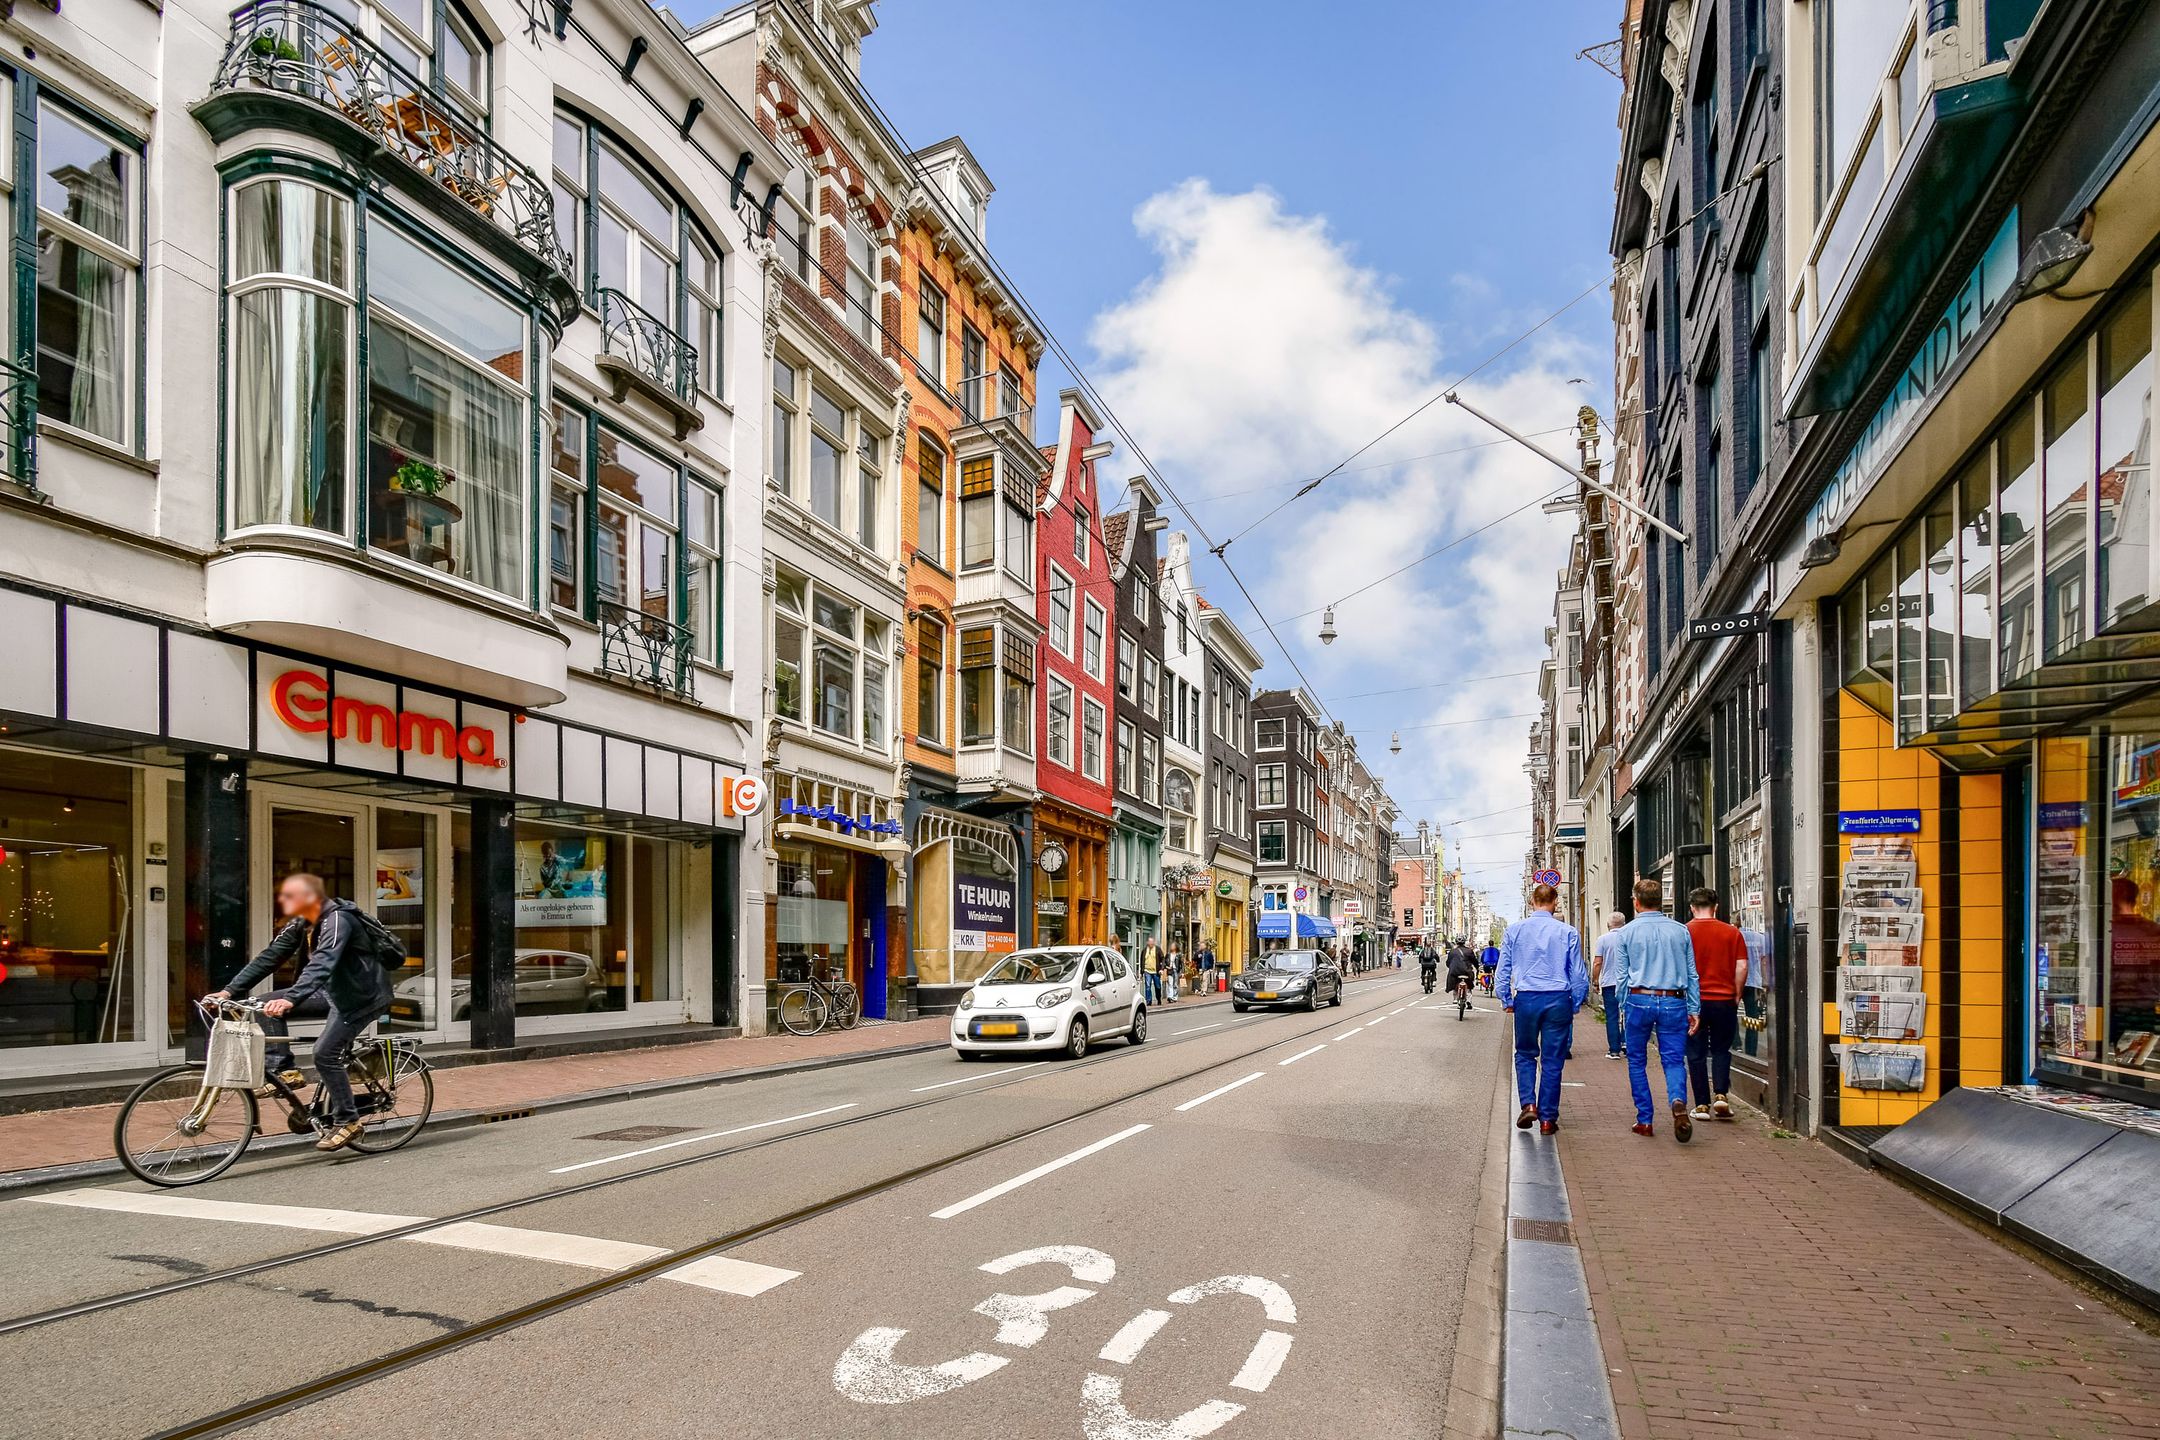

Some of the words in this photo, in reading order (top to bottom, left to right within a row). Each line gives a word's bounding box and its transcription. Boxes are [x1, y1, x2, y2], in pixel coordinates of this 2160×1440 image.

[1814, 254, 1996, 538] BOEKHANDEL
[1694, 615, 1760, 635] moooi
[1843, 816, 1880, 826] Frankfurter
[1879, 815, 1916, 825] Allgemeine
[958, 884, 976, 905] TE
[977, 886, 1011, 909] HUUR
[520, 904, 529, 912] Als
[967, 910, 1004, 923] Winkelruimte
[960, 934, 975, 946] KRK
[832, 1244, 1297, 1440] 30
